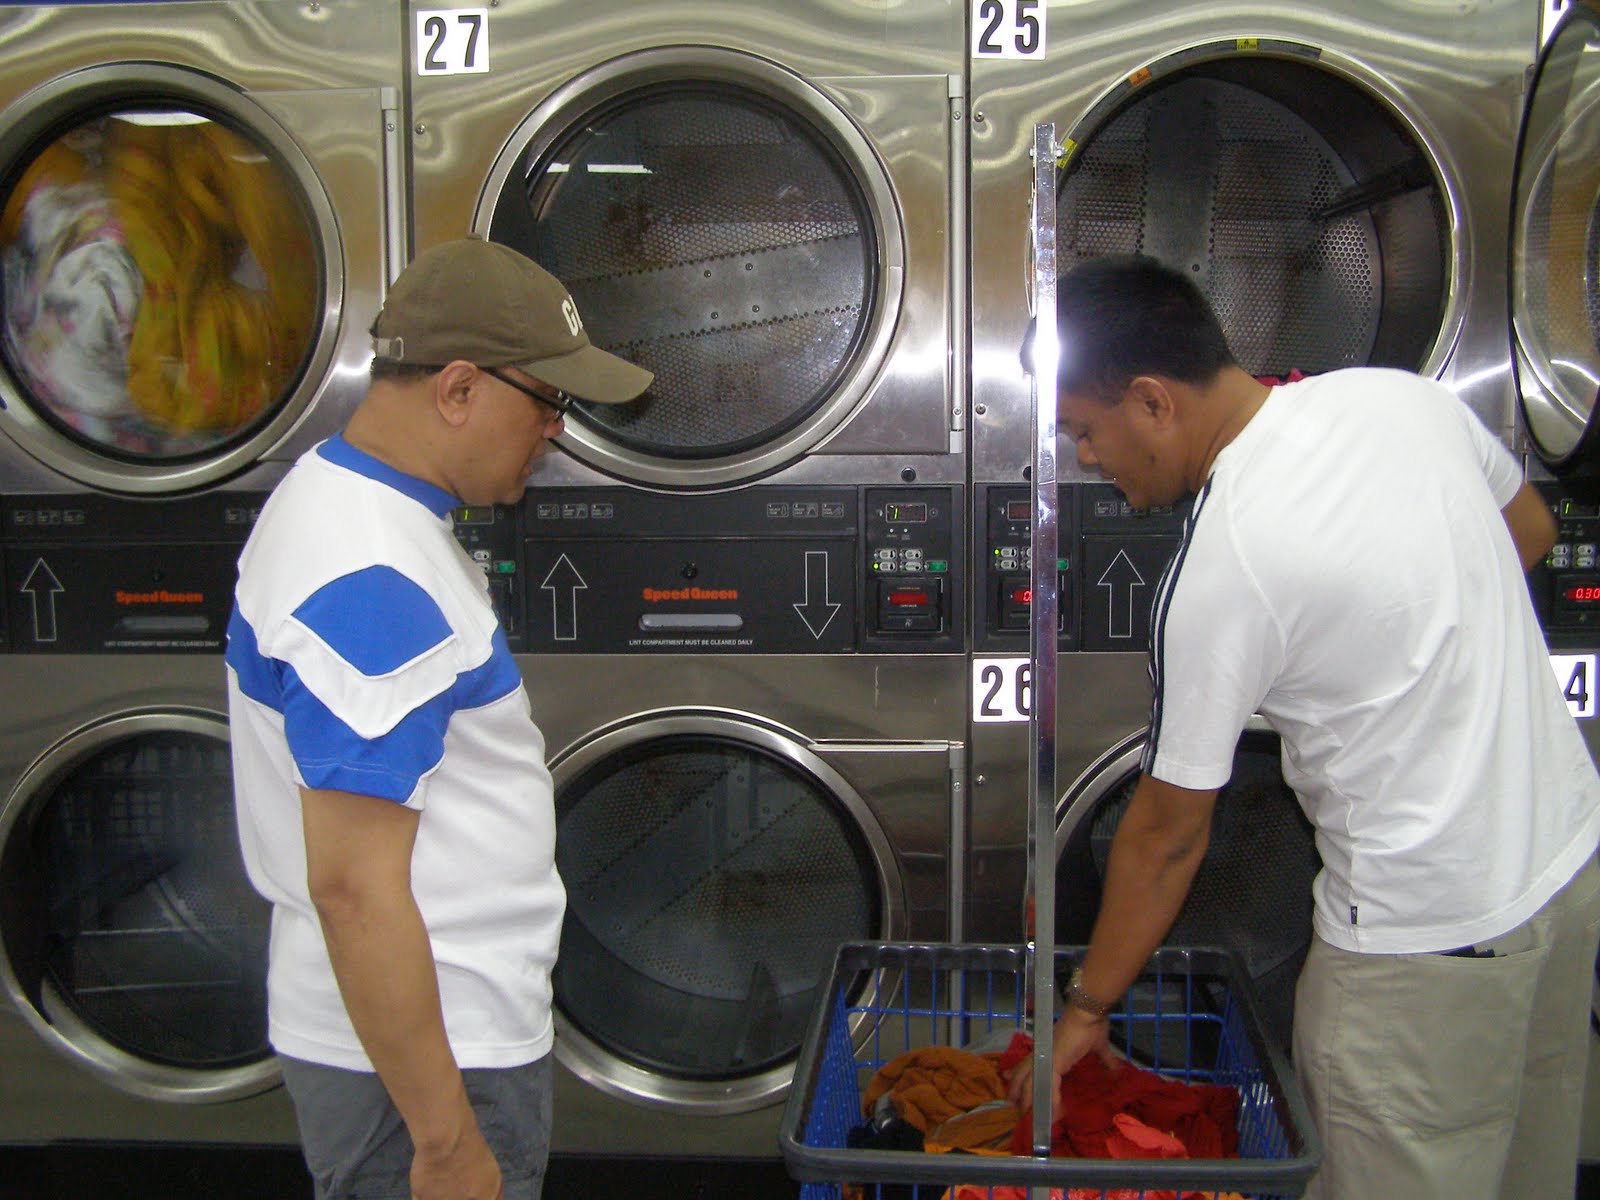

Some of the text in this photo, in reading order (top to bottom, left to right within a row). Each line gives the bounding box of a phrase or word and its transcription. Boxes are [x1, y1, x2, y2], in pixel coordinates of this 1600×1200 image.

[424, 14, 482, 71] 27
[978, 0, 1040, 54] 25
[980, 663, 1031, 717] 26
